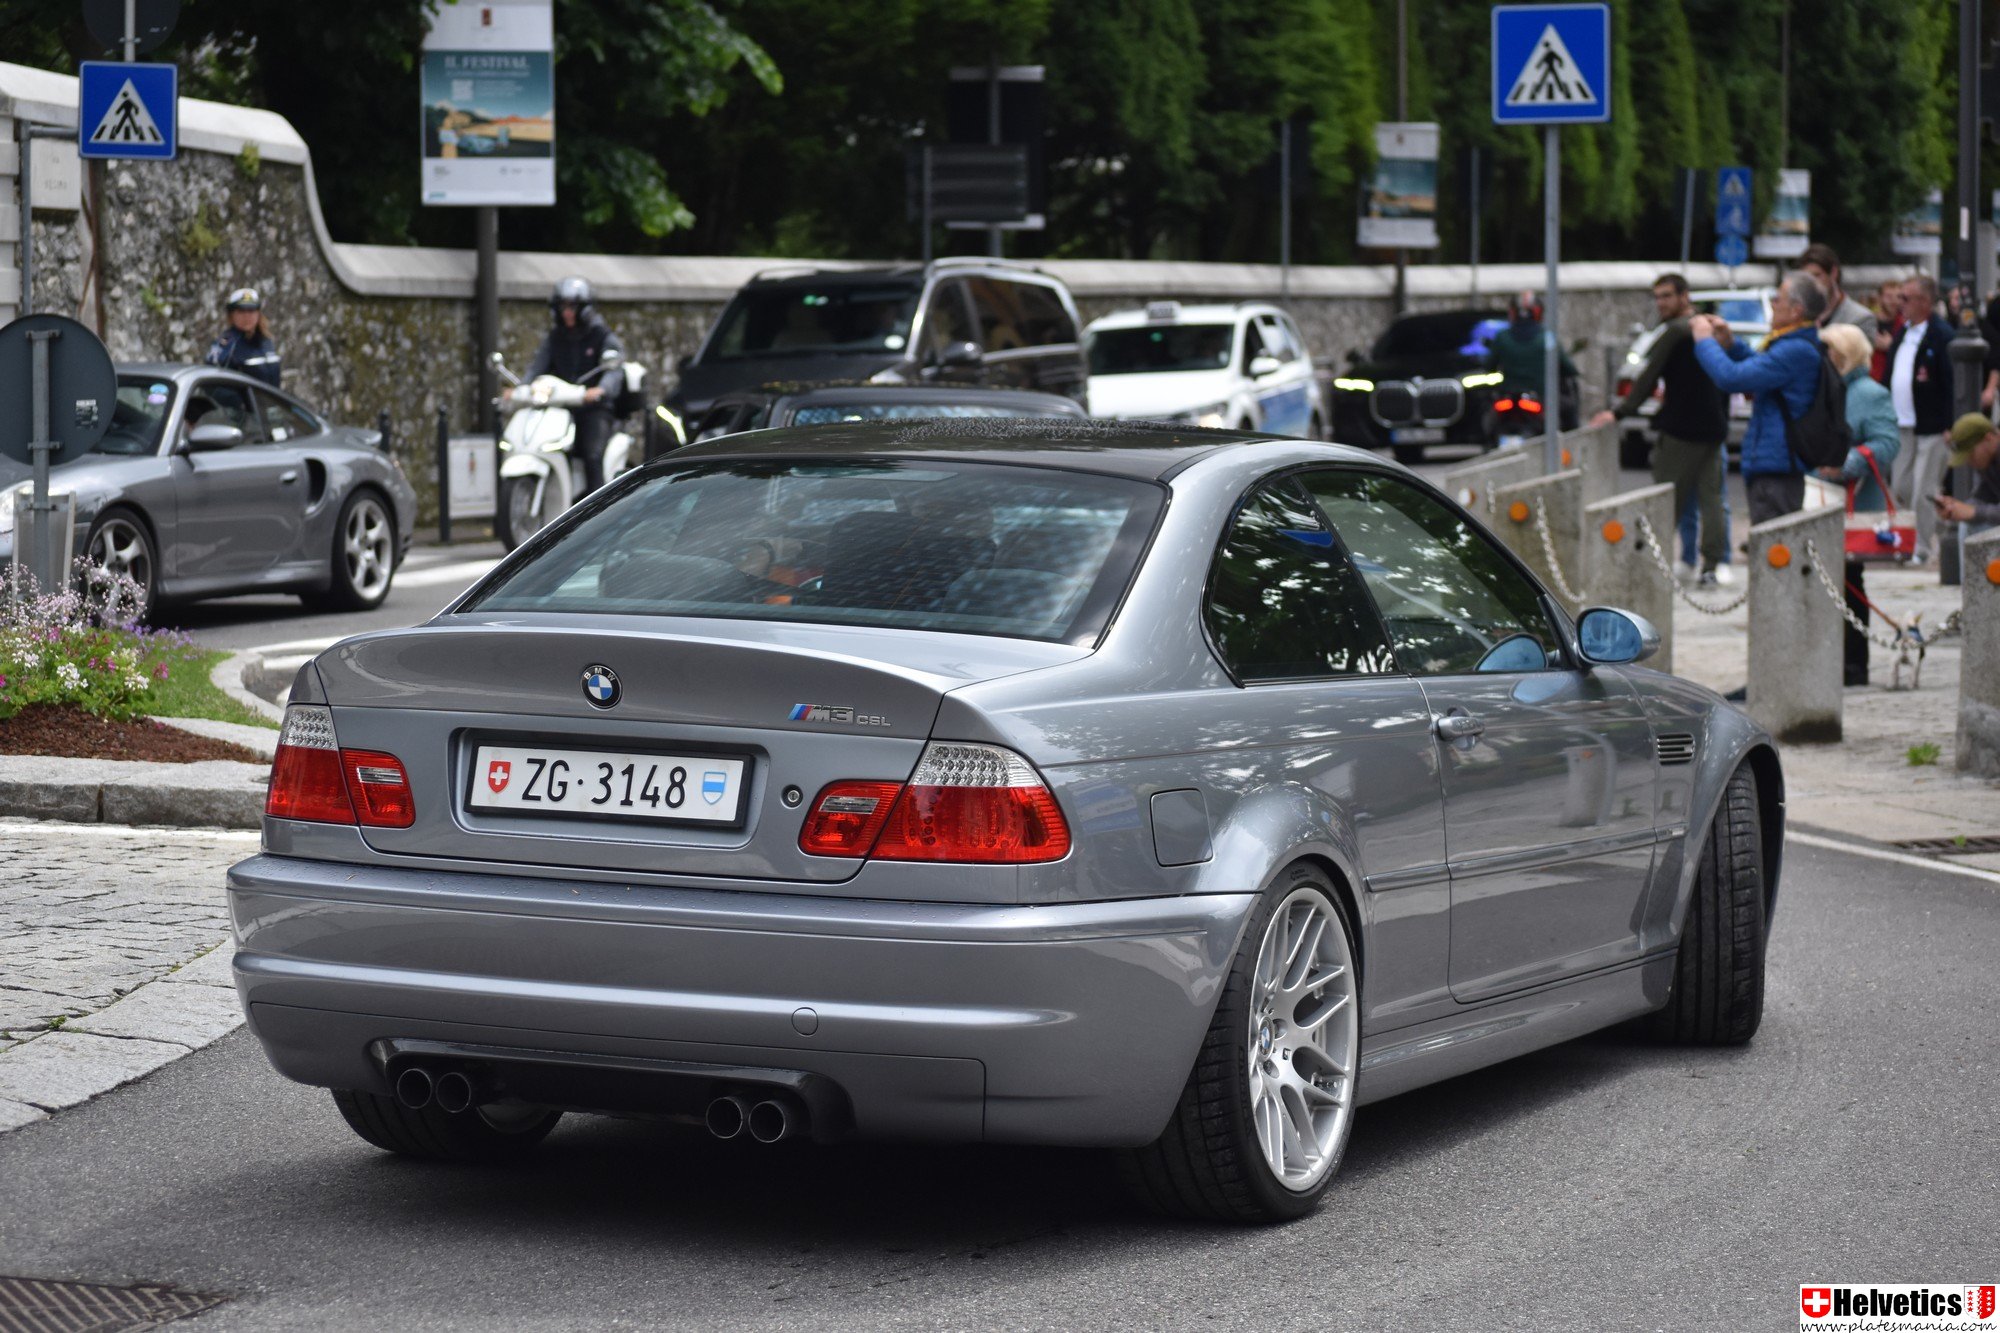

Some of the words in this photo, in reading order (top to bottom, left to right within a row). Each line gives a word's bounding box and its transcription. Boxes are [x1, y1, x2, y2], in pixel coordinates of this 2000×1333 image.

[583, 667, 616, 682] BMW
[805, 704, 854, 725] M3
[856, 714, 892, 727] CSL
